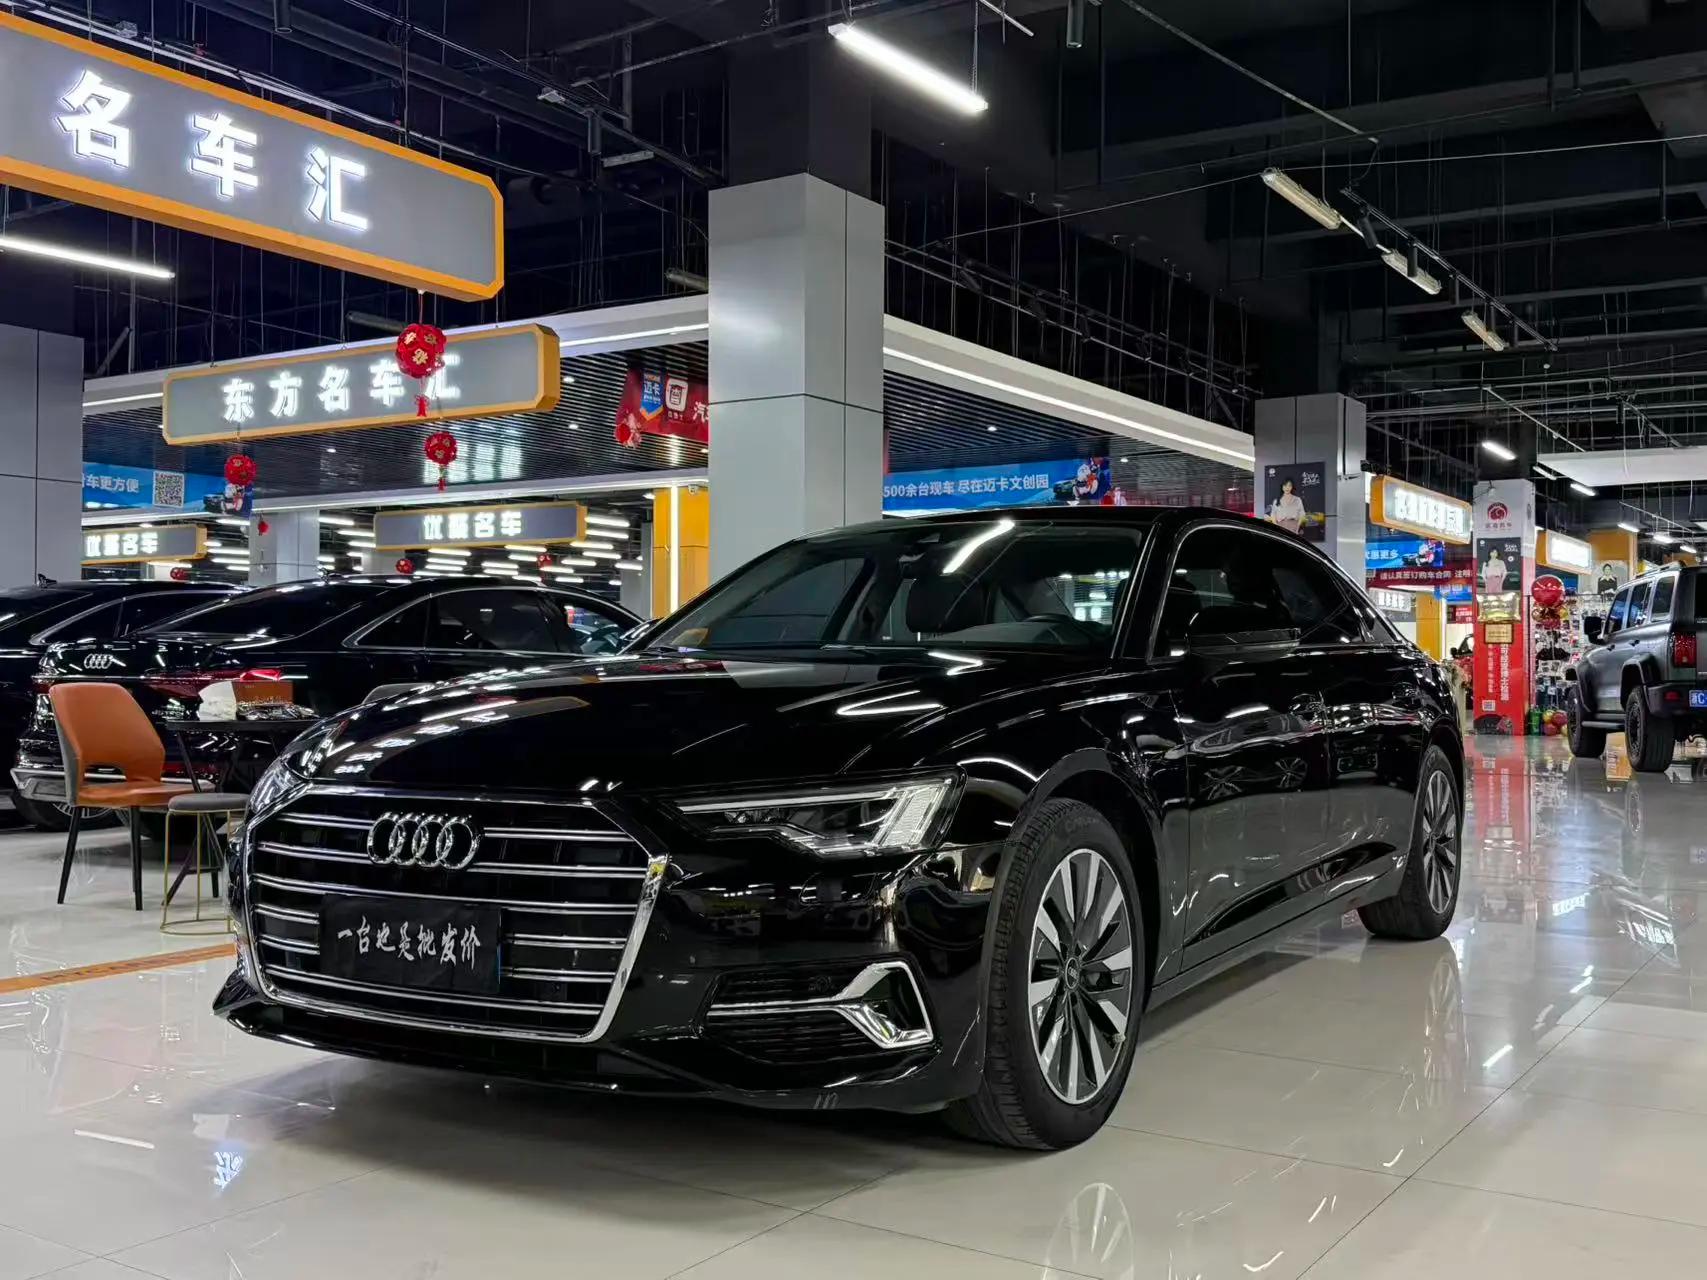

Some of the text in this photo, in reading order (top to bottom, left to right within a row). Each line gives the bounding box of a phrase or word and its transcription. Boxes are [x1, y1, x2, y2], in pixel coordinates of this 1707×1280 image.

[56, 69, 370, 231] 名车汇
[82, 473, 139, 494] 车更方便
[958, 474, 1050, 494] 尽在迈卡文创园
[337, 915, 481, 970] 一台也是批发价
